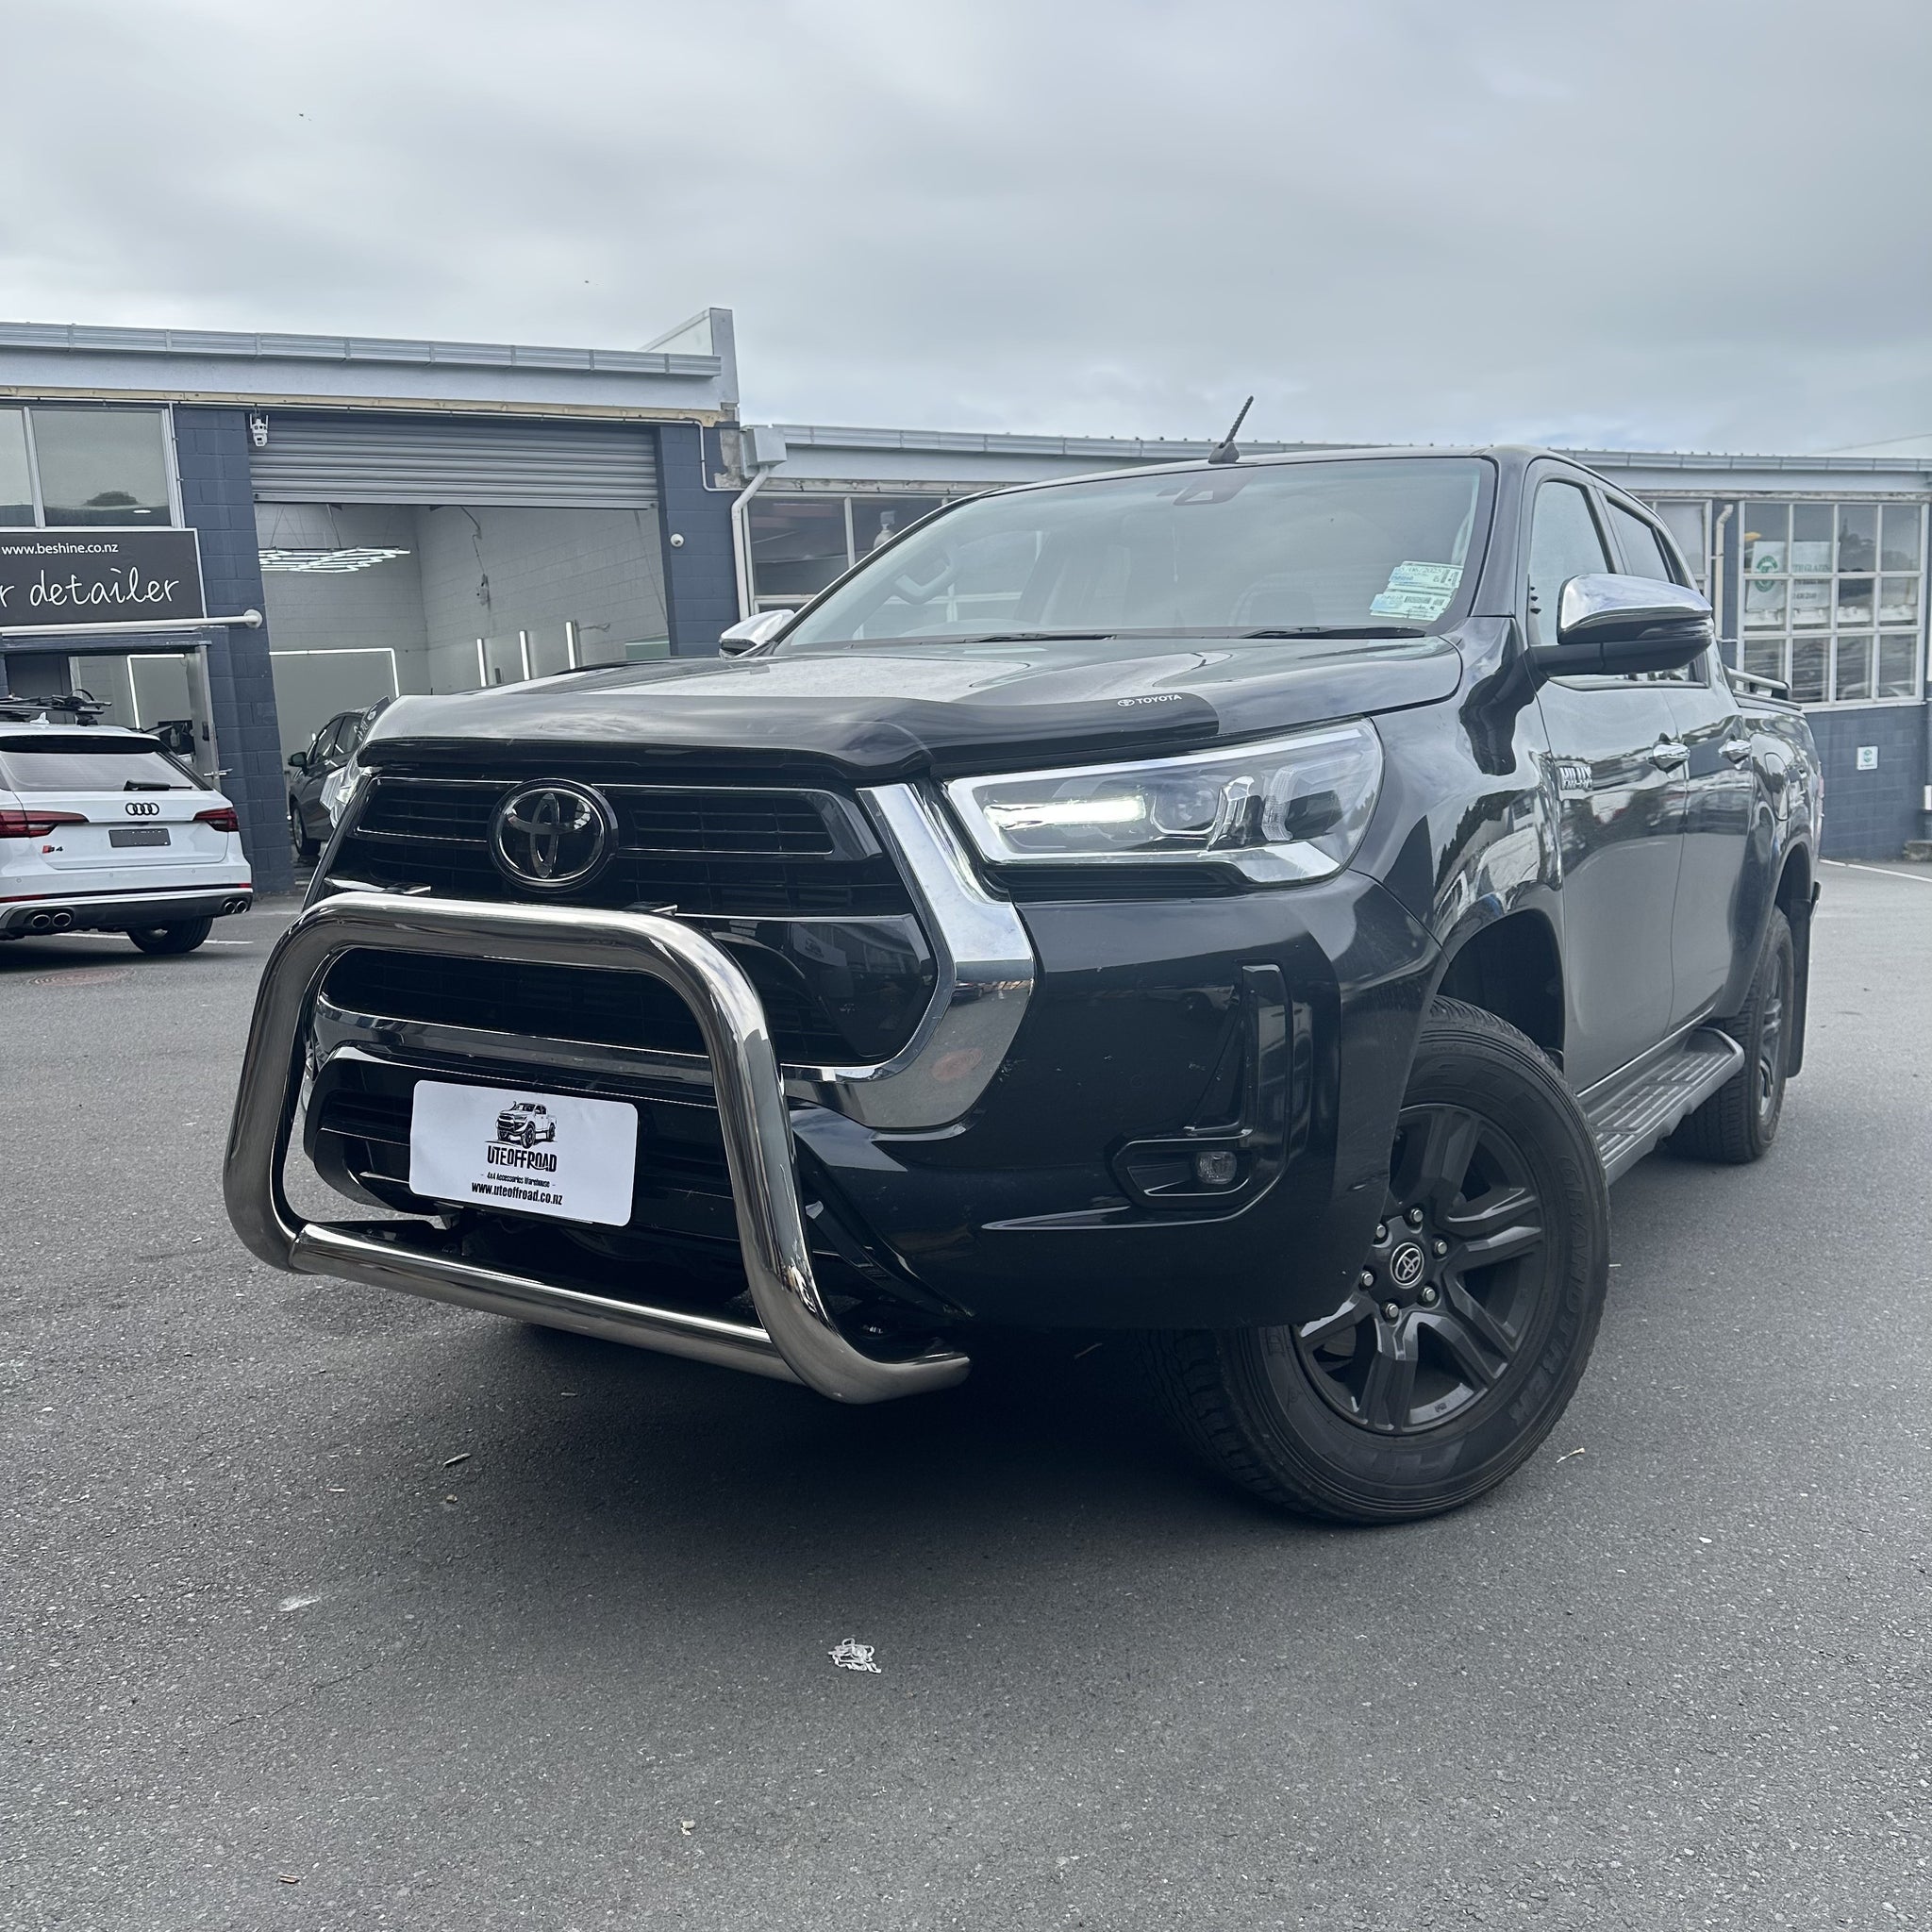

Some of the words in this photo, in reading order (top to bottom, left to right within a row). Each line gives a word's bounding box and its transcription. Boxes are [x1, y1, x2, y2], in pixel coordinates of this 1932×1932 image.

[1, 542, 119, 555] www.beshine.co.nz
[29, 566, 180, 607] detailer
[1136, 694, 1183, 705] TOYOTA
[486, 1171, 496, 1180] 4x4
[496, 1173, 525, 1185] Accessories
[524, 1176, 551, 1189] Warehouse
[471, 1181, 563, 1206] www.uteoffroad.co.nz
